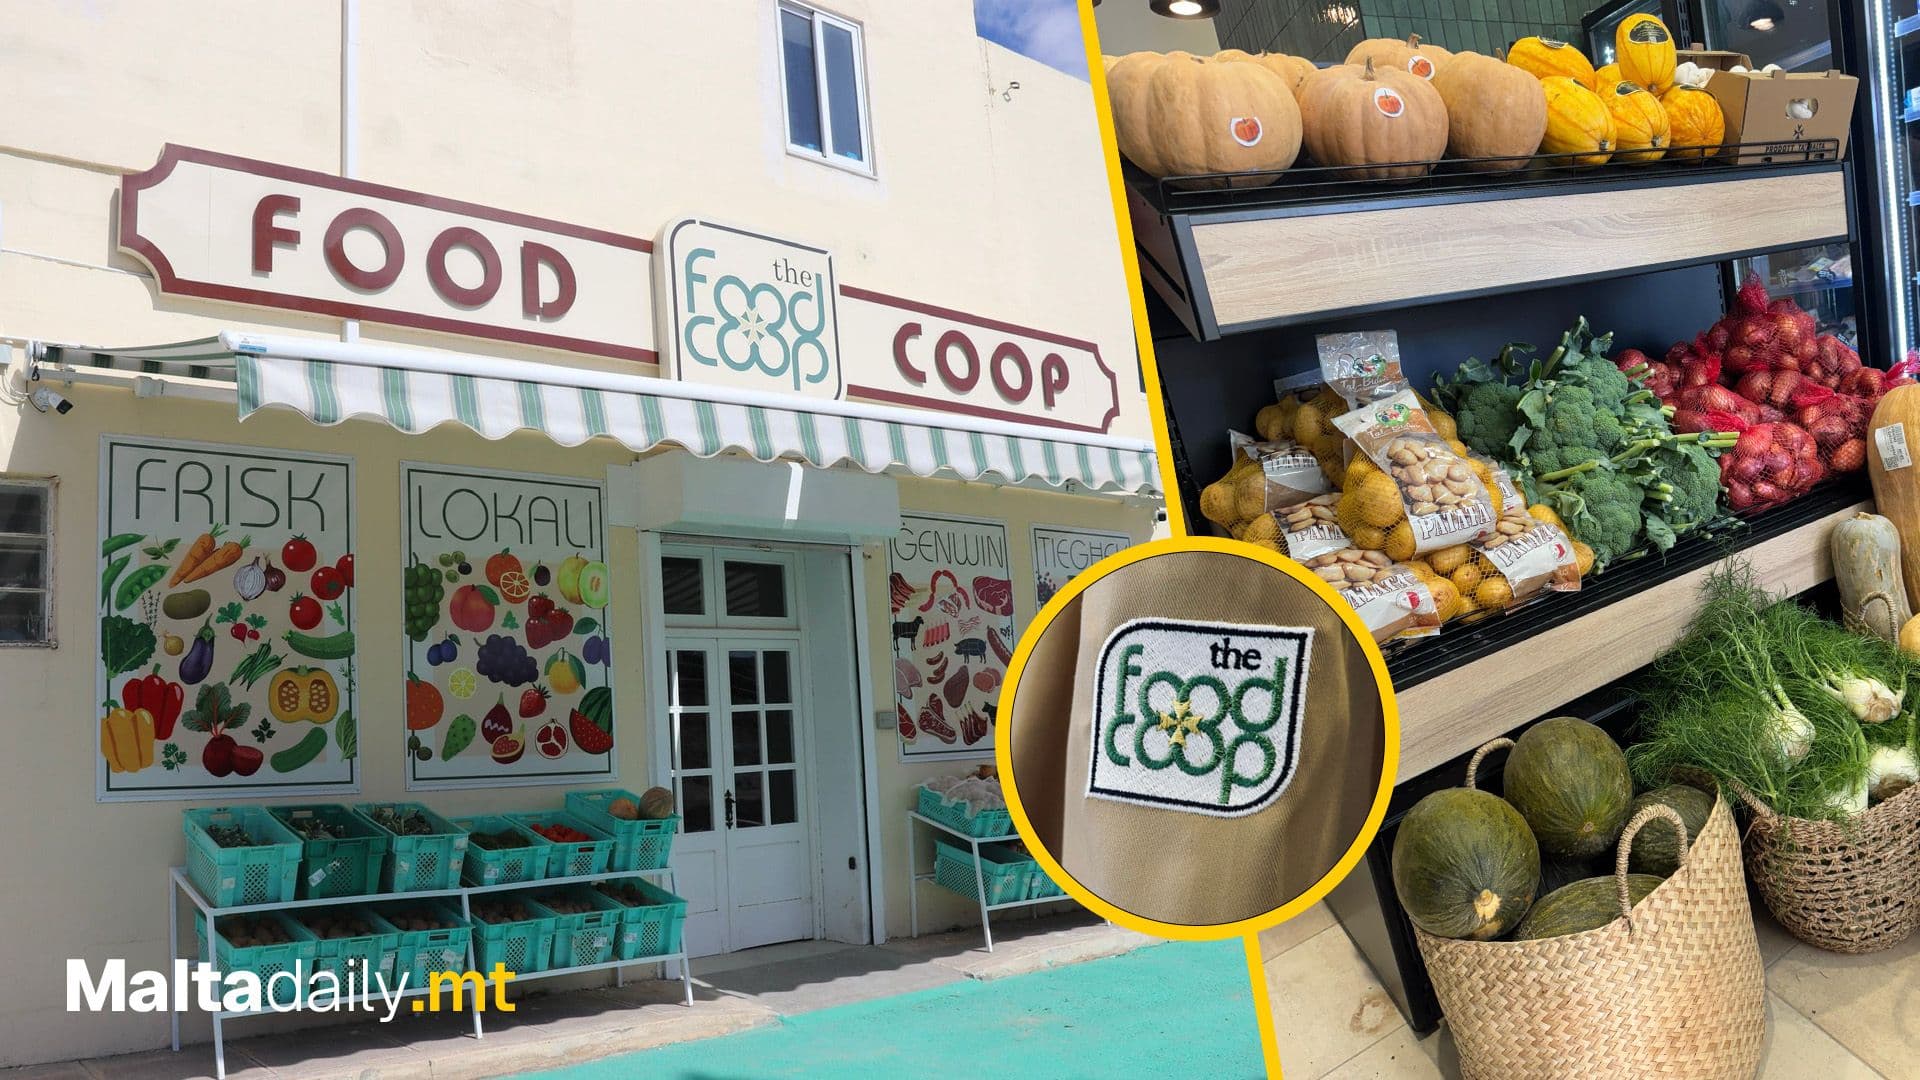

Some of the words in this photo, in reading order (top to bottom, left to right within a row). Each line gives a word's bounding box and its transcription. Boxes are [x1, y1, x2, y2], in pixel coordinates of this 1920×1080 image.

[252, 194, 577, 319] FOOD
[773, 258, 812, 287] the
[893, 322, 1069, 407] COOP
[135, 458, 326, 532] FRISK
[418, 485, 594, 550] LOKALI
[1418, 503, 1491, 541] PATATA
[1343, 572, 1415, 610] ATATA
[1210, 638, 1261, 670] the
